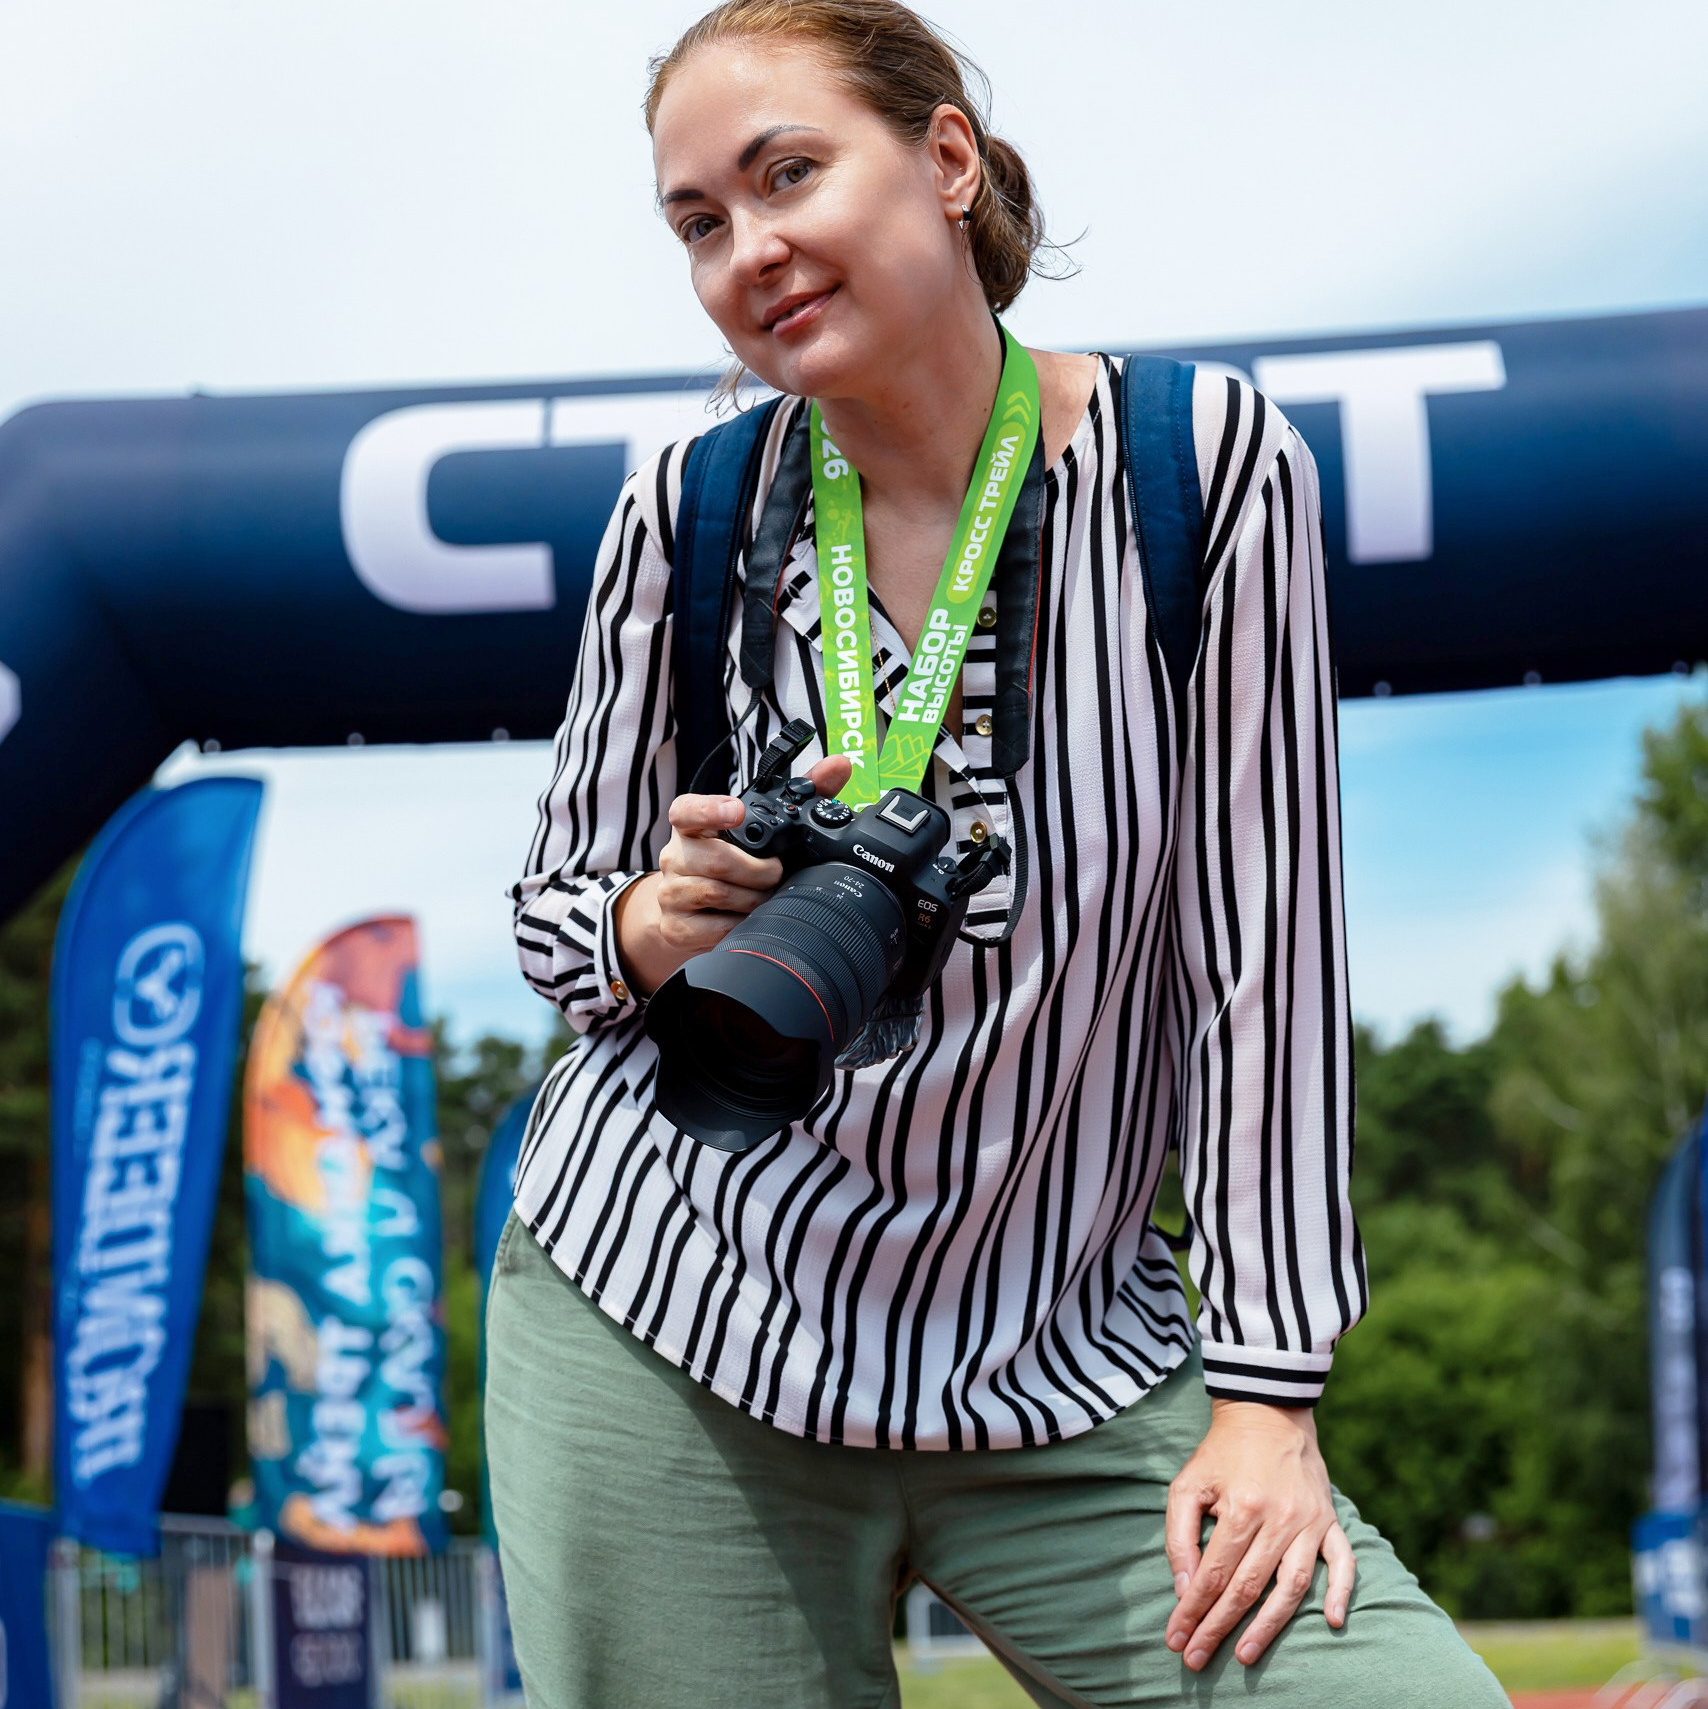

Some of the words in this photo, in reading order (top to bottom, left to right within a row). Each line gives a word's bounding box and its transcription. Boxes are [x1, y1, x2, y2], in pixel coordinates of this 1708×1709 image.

[953, 515, 991, 591] КРОСС
[978, 435, 1019, 511] ТРЕЙЛ
[830, 544, 865, 769] НОВОСИБИРСК
[897, 608, 952, 723] НАБОР
[921, 624, 969, 724] ВЫСОТЫ
[853, 844, 894, 873] Canon
[833, 880, 863, 899] Canon
[843, 875, 865, 890] 24-70
[917, 899, 939, 913] EOS
[917, 912, 931, 924] R6
